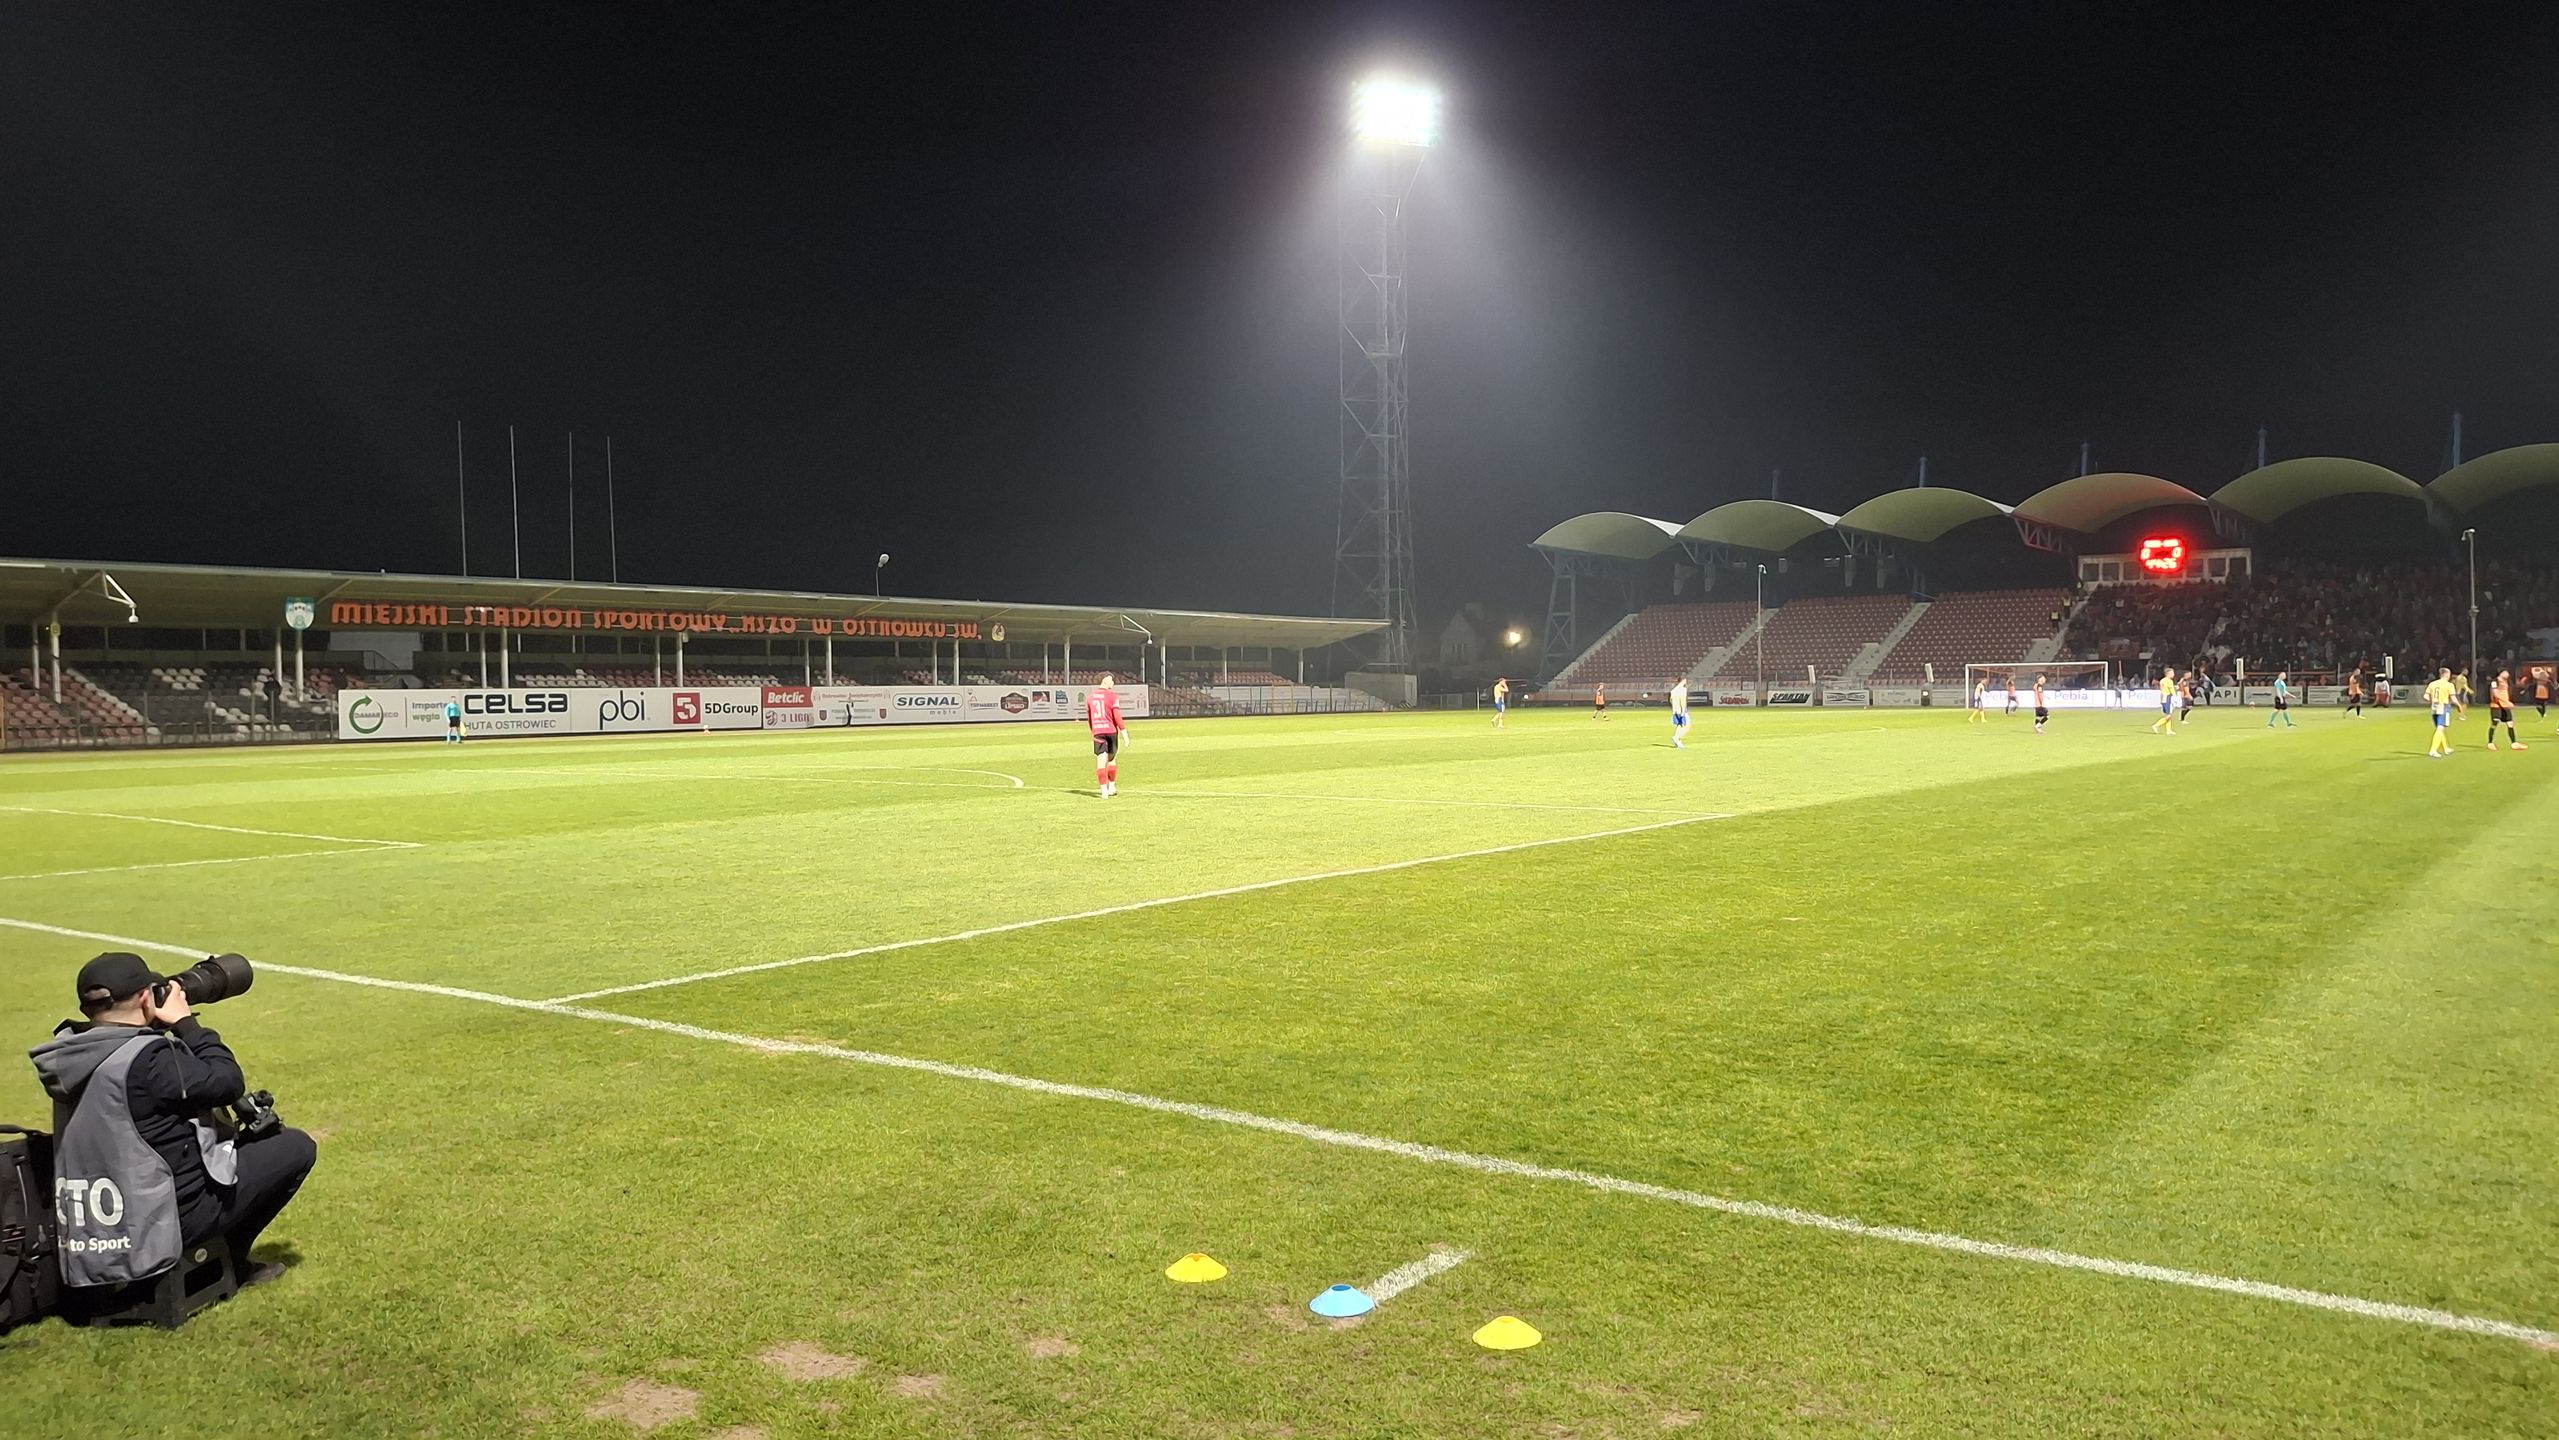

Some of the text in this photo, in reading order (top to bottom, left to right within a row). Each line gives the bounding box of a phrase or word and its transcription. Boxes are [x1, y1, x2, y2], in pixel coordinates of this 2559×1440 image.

[331, 602, 449, 626] MIEJSKI
[463, 605, 582, 628] STADION
[593, 609, 727, 632] SPORTOWY
[812, 617, 833, 635] W
[842, 618, 946, 638] OSTROWCU
[767, 691, 805, 704] Betclic
[896, 696, 959, 706] SIGNAL
[600, 690, 645, 730] pbi
[705, 702, 759, 716] 5DGroup
[790, 713, 810, 723] LIGA
[466, 719, 557, 731] HUTA OSTROWIEC
[89, 1235, 132, 1255] Sport
